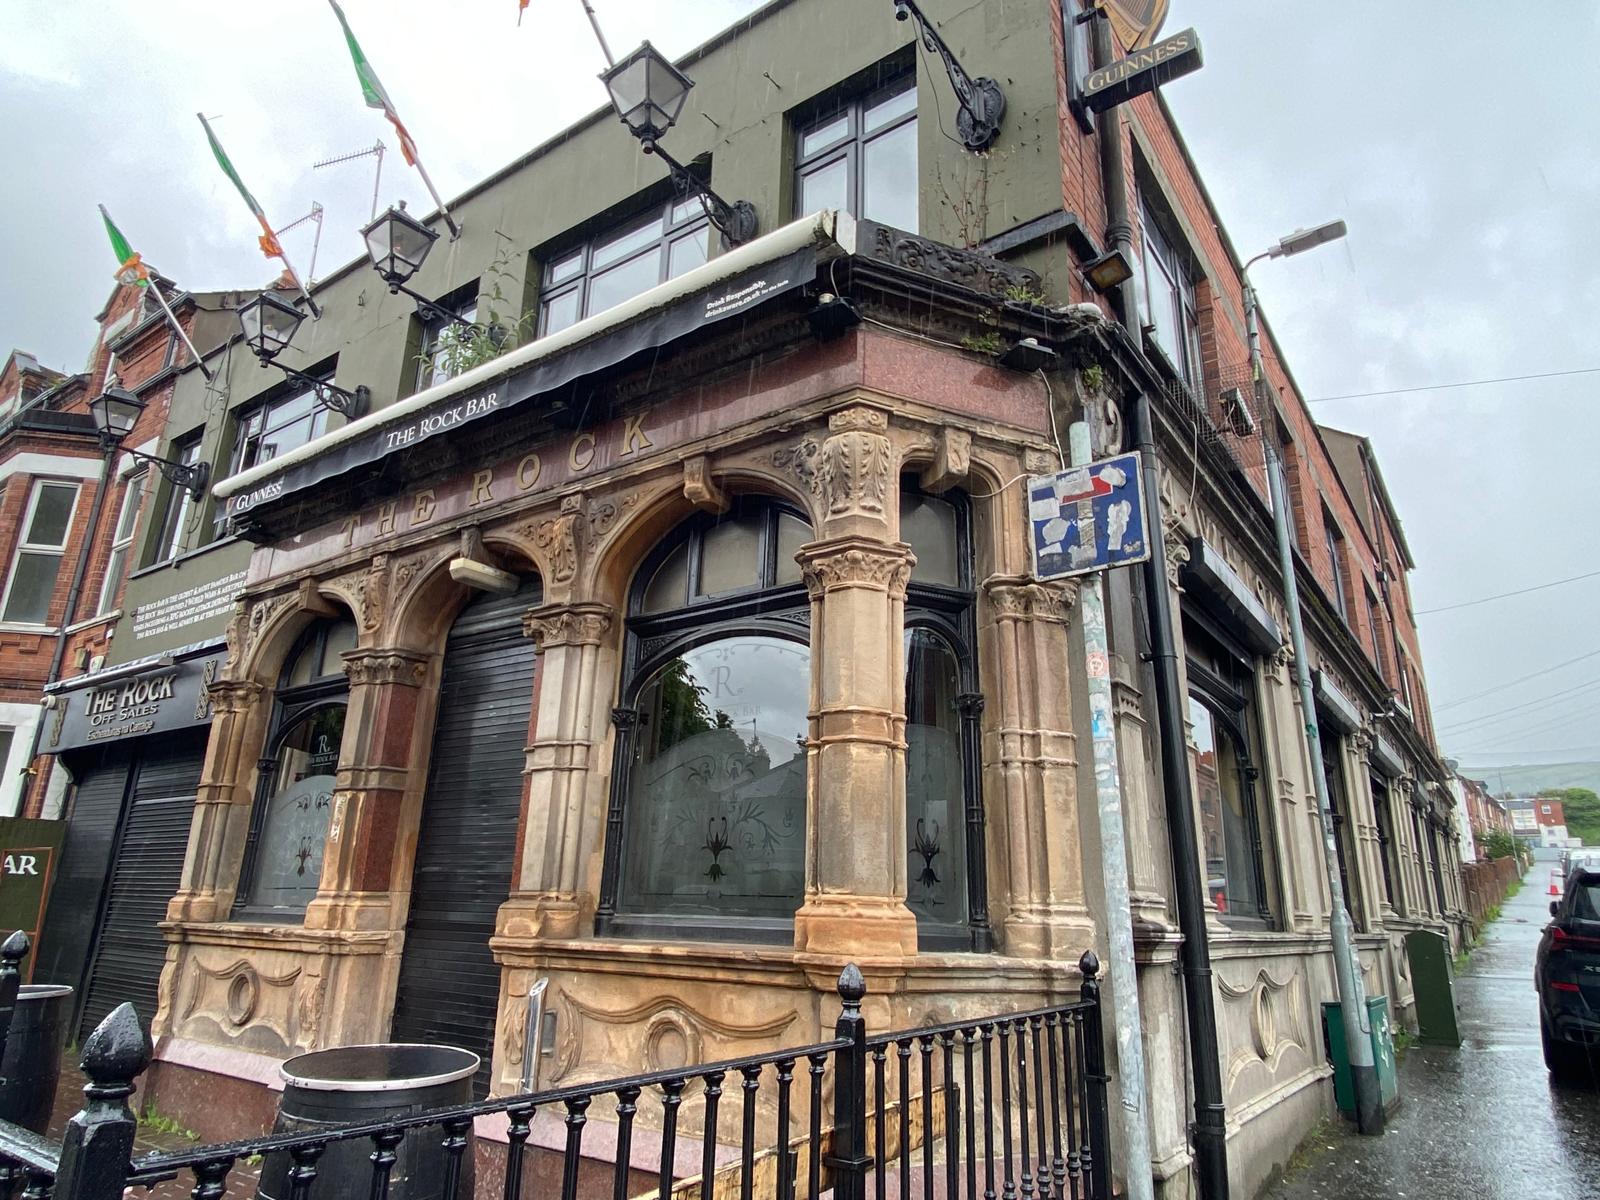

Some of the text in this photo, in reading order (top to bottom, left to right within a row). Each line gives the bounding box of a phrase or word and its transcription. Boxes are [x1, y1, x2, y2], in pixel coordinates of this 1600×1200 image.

[1088, 35, 1188, 90] GUINNESS
[705, 291, 761, 318] drinkaware.co.uk
[707, 280, 767, 310] Drink Responsibly.
[386, 392, 498, 448] THE ROCK BAR
[236, 481, 284, 510] GUINNESS
[340, 412, 653, 549] THE ROCK
[146, 601, 158, 611] ROCK
[85, 674, 176, 716] THE ROCK
[91, 704, 159, 726] OFF SALES
